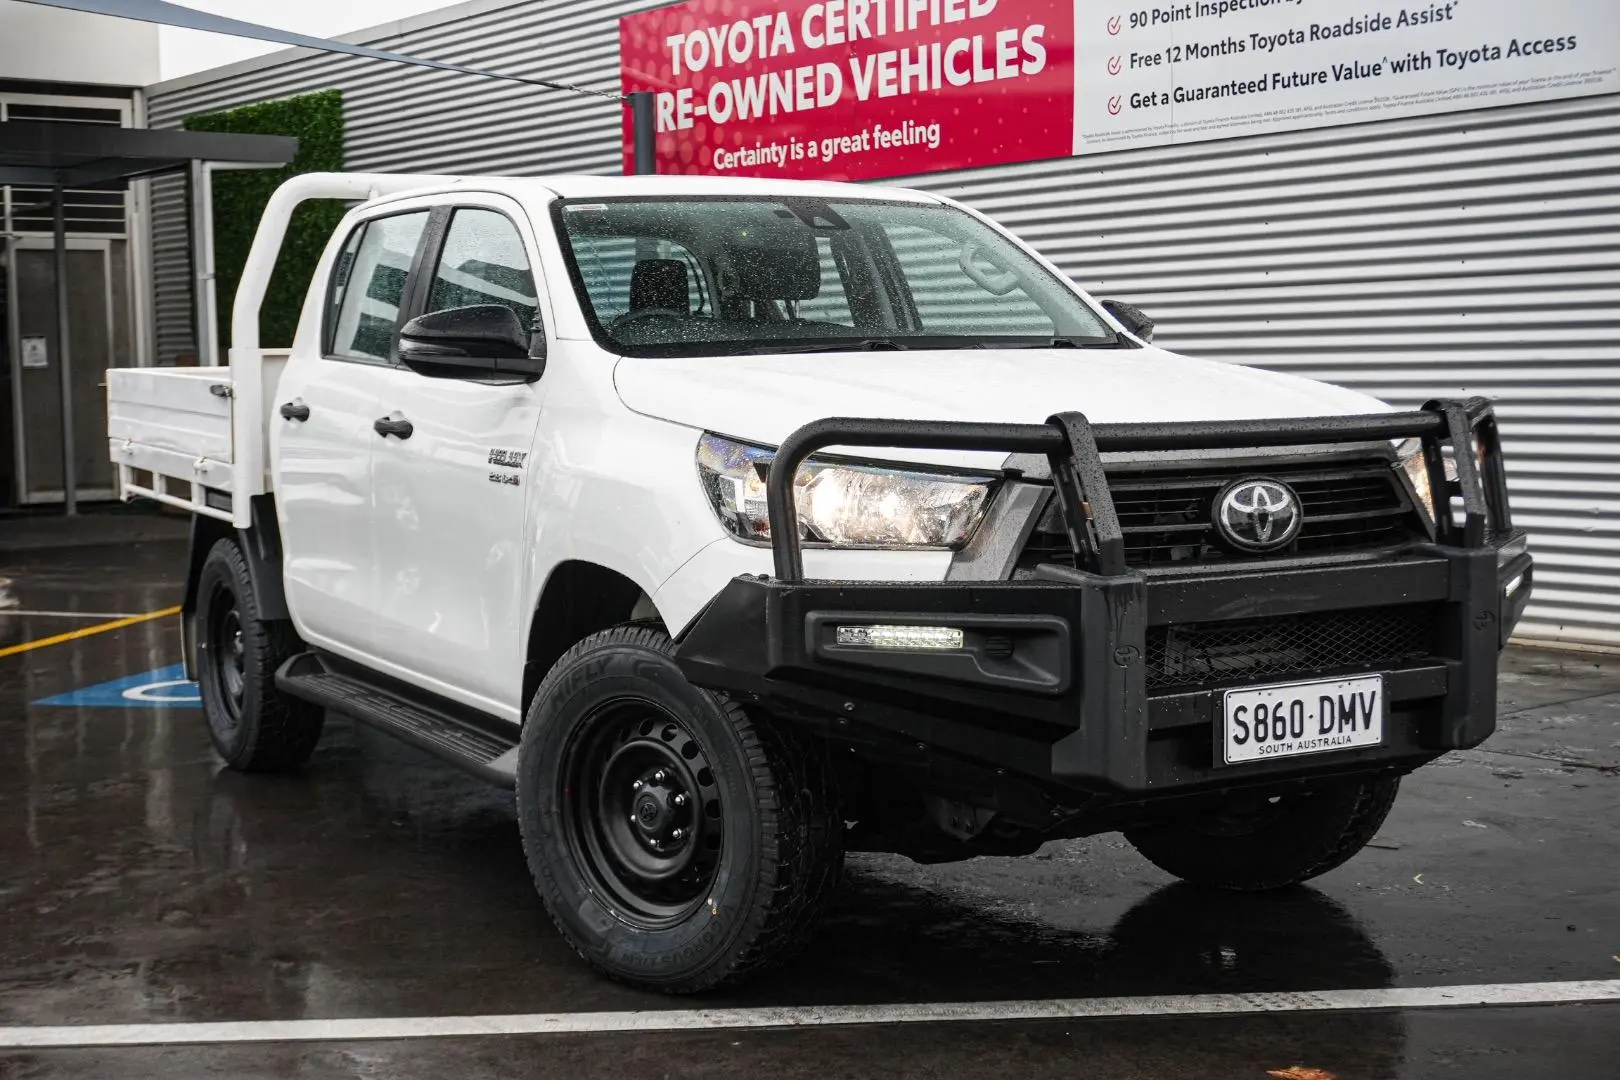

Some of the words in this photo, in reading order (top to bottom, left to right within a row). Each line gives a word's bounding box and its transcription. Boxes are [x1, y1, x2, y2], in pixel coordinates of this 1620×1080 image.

[666, 11, 795, 76] TOYOTA
[1130, 12, 1148, 29] 90
[1152, 5, 1192, 26] Point
[1130, 53, 1162, 69] Free
[1166, 46, 1181, 63] 12
[1185, 37, 1246, 60] Months
[1250, 29, 1305, 52] Toyota
[1310, 13, 1392, 41] Roadside
[656, 62, 843, 133] RE-OWNED
[849, 24, 1047, 101] VEHICLES
[1130, 92, 1156, 109] Get
[1161, 92, 1169, 105] a
[1173, 74, 1268, 103] Guaranteed
[1272, 68, 1327, 90] Future
[1391, 54, 1432, 74] with
[1437, 44, 1501, 70] Toyota
[1507, 35, 1577, 58] Access
[713, 140, 787, 170] Certainty
[790, 138, 804, 160] is
[808, 139, 818, 157] a
[821, 132, 870, 161] great
[873, 120, 940, 152] feeling
[1259, 742, 1293, 755] SOUTH
[1297, 735, 1352, 751] AUSTRALIA
